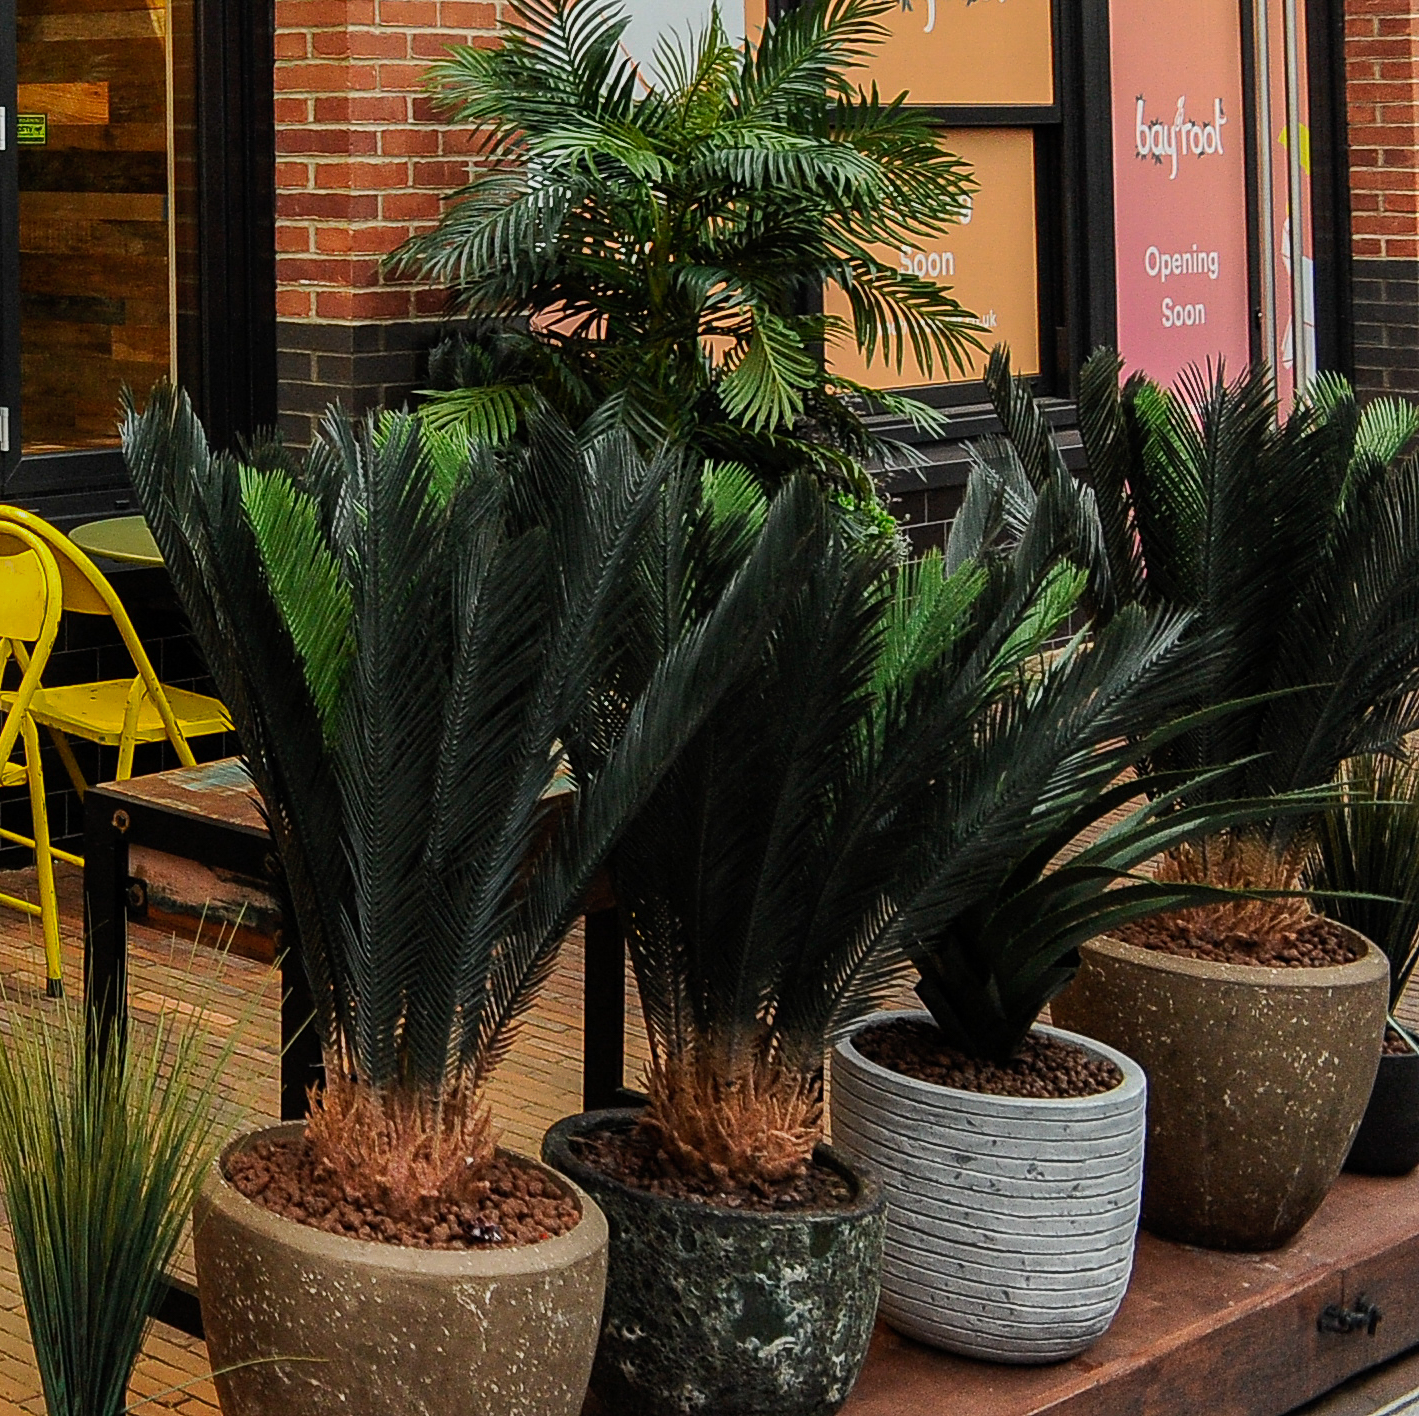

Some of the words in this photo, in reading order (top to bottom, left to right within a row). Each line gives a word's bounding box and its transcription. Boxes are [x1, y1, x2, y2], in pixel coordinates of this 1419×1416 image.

[899, 244, 955, 278] Soon
[1145, 243, 1219, 282] Opening
[1162, 297, 1206, 328] Soon
